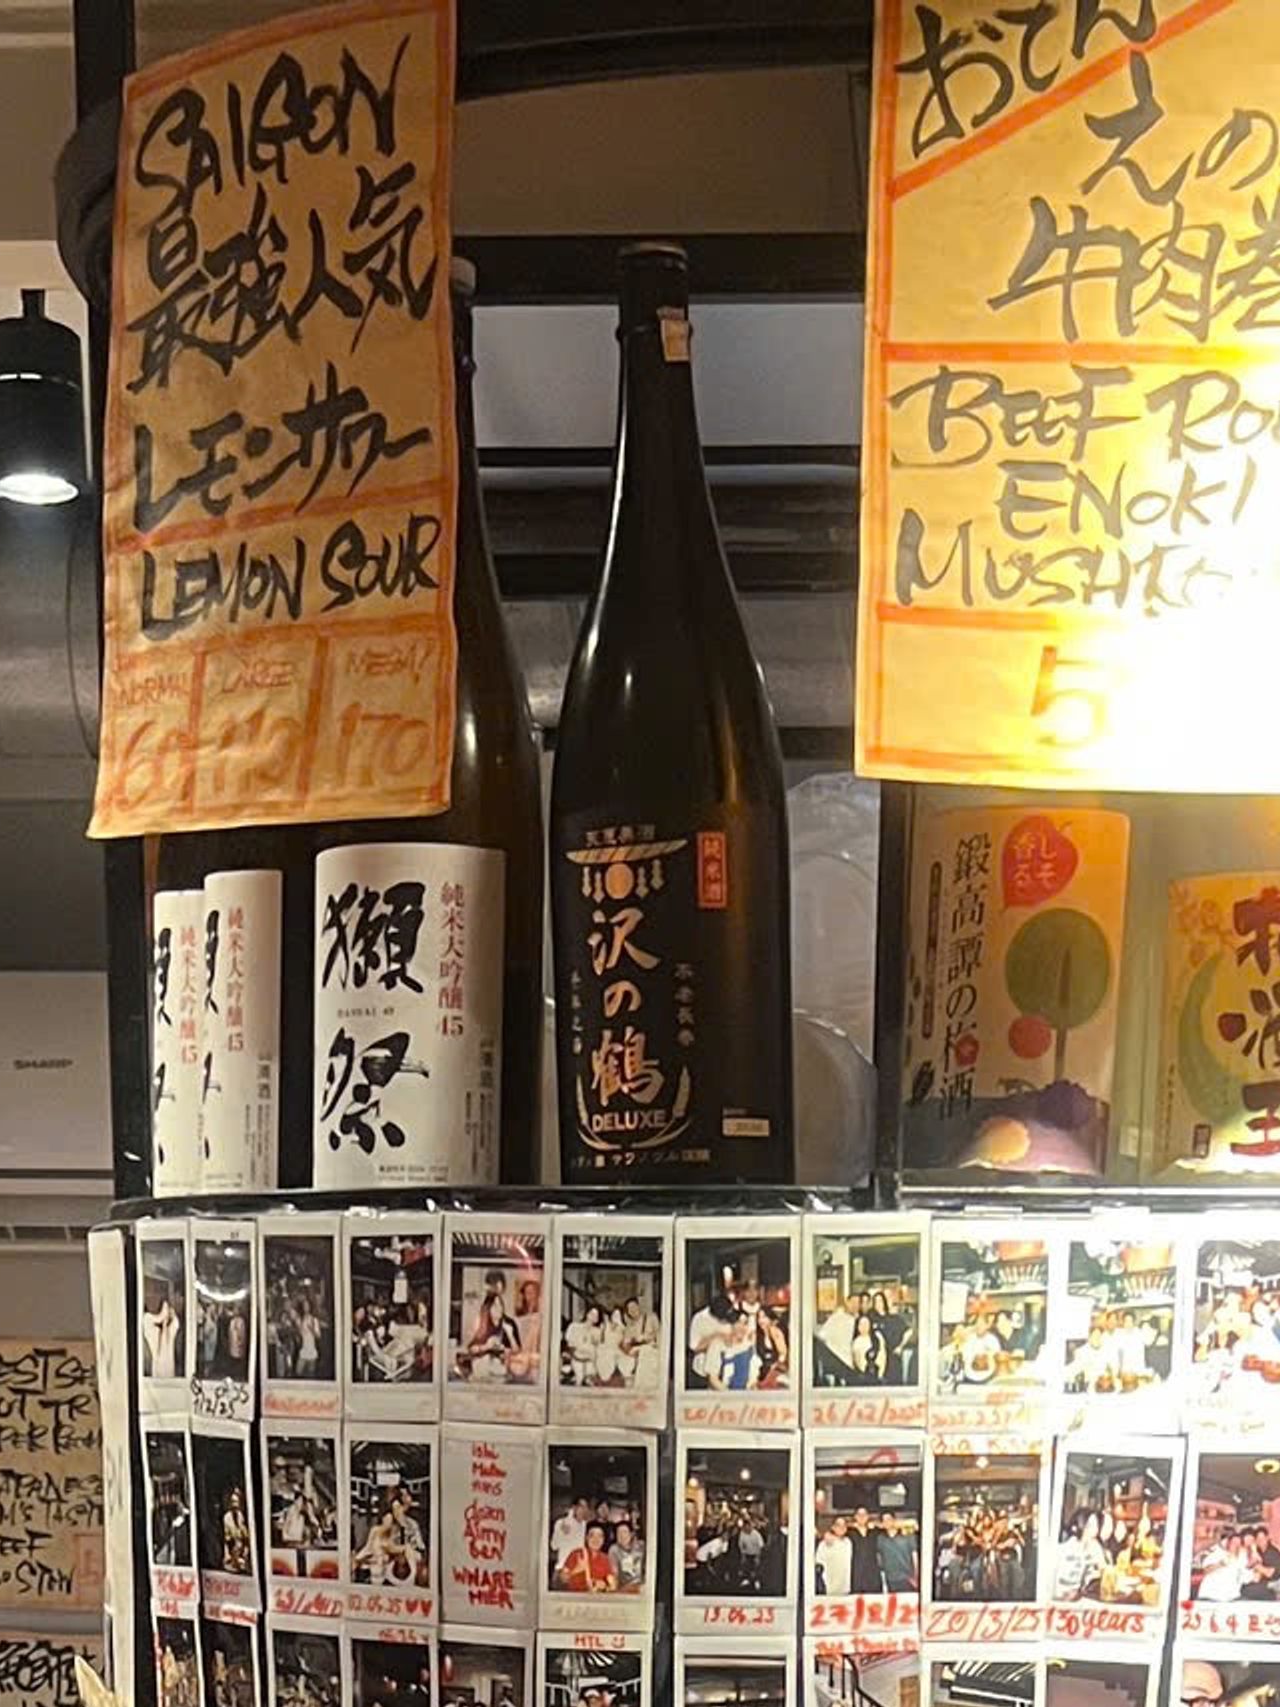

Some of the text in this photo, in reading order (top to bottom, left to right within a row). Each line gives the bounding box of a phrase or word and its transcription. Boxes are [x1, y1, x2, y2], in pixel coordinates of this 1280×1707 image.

[136, 33, 410, 203] SAIGON
[131, 362, 432, 531] レモンサワー
[888, 364, 1139, 469] BEEF
[995, 458, 1257, 539] ENOKI
[140, 513, 439, 639] LEMON SOUR
[587, 907, 664, 1107] 沢の鶴
[592, 1111, 667, 1132] DELUXE
